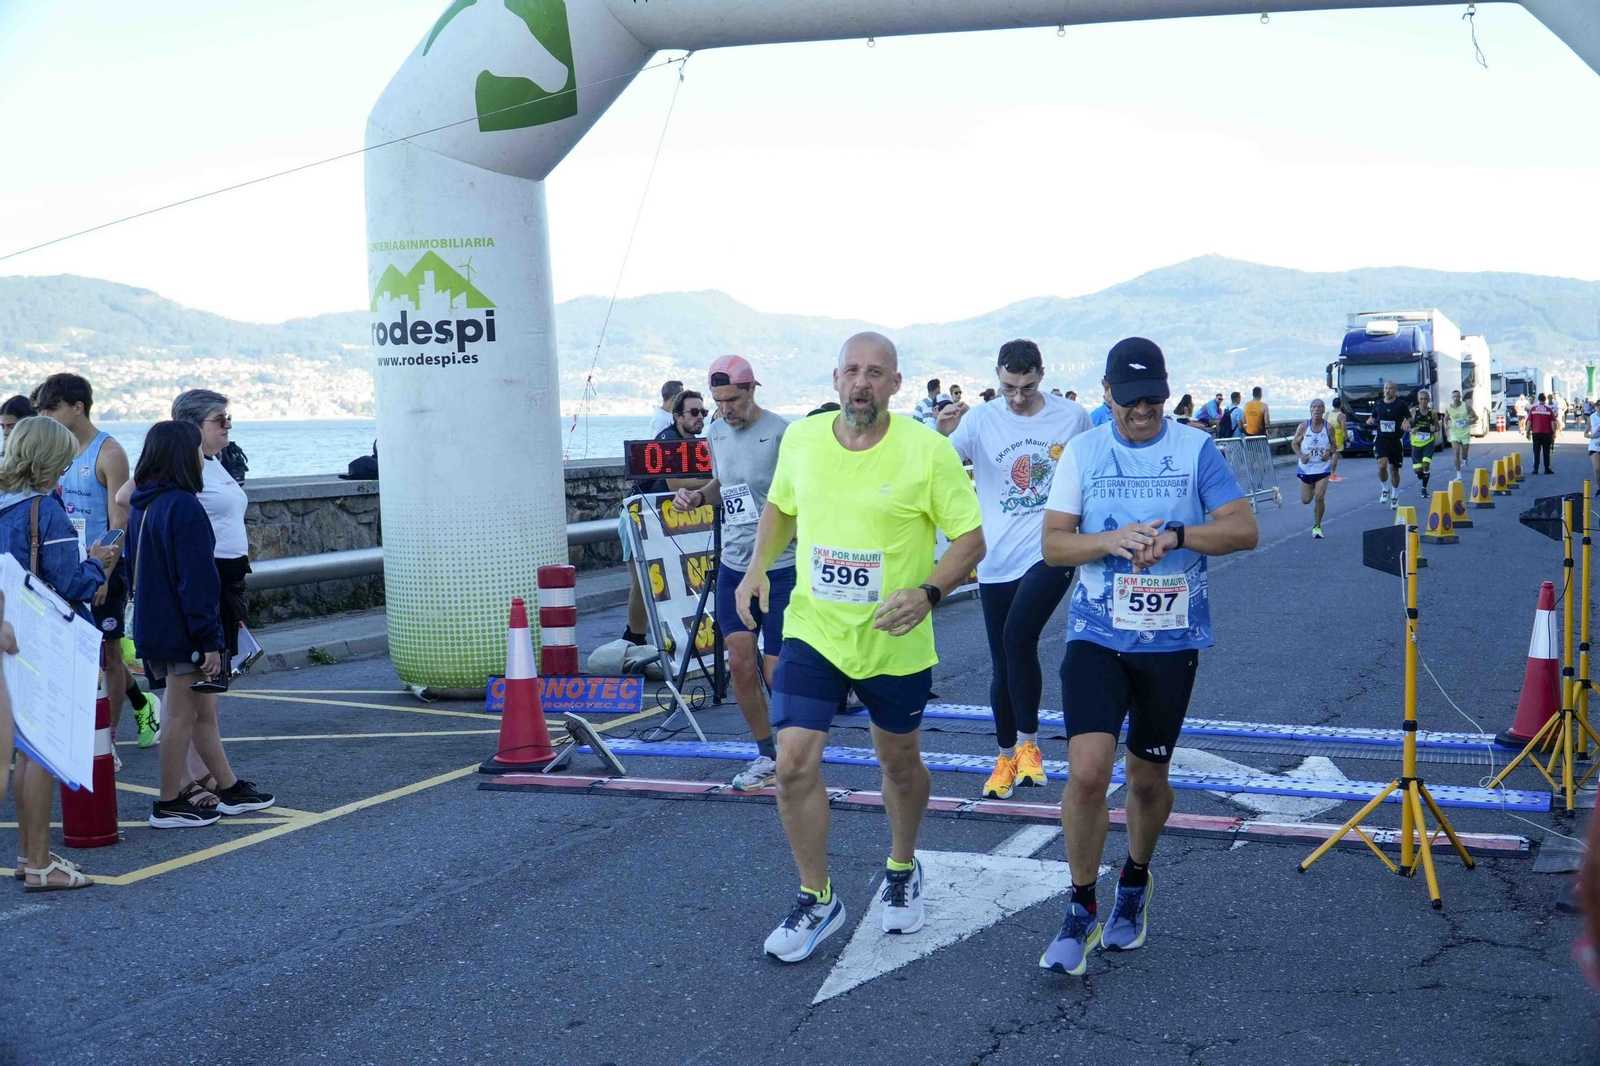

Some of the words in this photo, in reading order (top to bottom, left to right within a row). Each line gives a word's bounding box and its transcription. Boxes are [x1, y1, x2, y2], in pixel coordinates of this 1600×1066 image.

[371, 309, 496, 353] rodespi
[377, 352, 479, 368] www.rodespi.es
[995, 447, 1011, 463] 5Km
[1010, 440, 1023, 451] por
[1025, 438, 1049, 448] Mauri
[1107, 479, 1126, 488] GRAN
[1127, 480, 1150, 488] FONDO
[1151, 479, 1189, 488] CAIXABANK
[1093, 488, 1171, 499] PONTEVEDRA
[1176, 487, 1187, 498] 24
[725, 498, 746, 515] 82
[813, 547, 830, 558] 5KM
[831, 550, 850, 560] POR
[852, 552, 881, 562] MAURI
[821, 563, 870, 587] 596
[1118, 576, 1138, 586] 5KM
[1140, 577, 1160, 587] POR
[1162, 576, 1187, 587] MAURI
[1128, 592, 1179, 613] 597
[492, 677, 638, 699] CNOTEC
